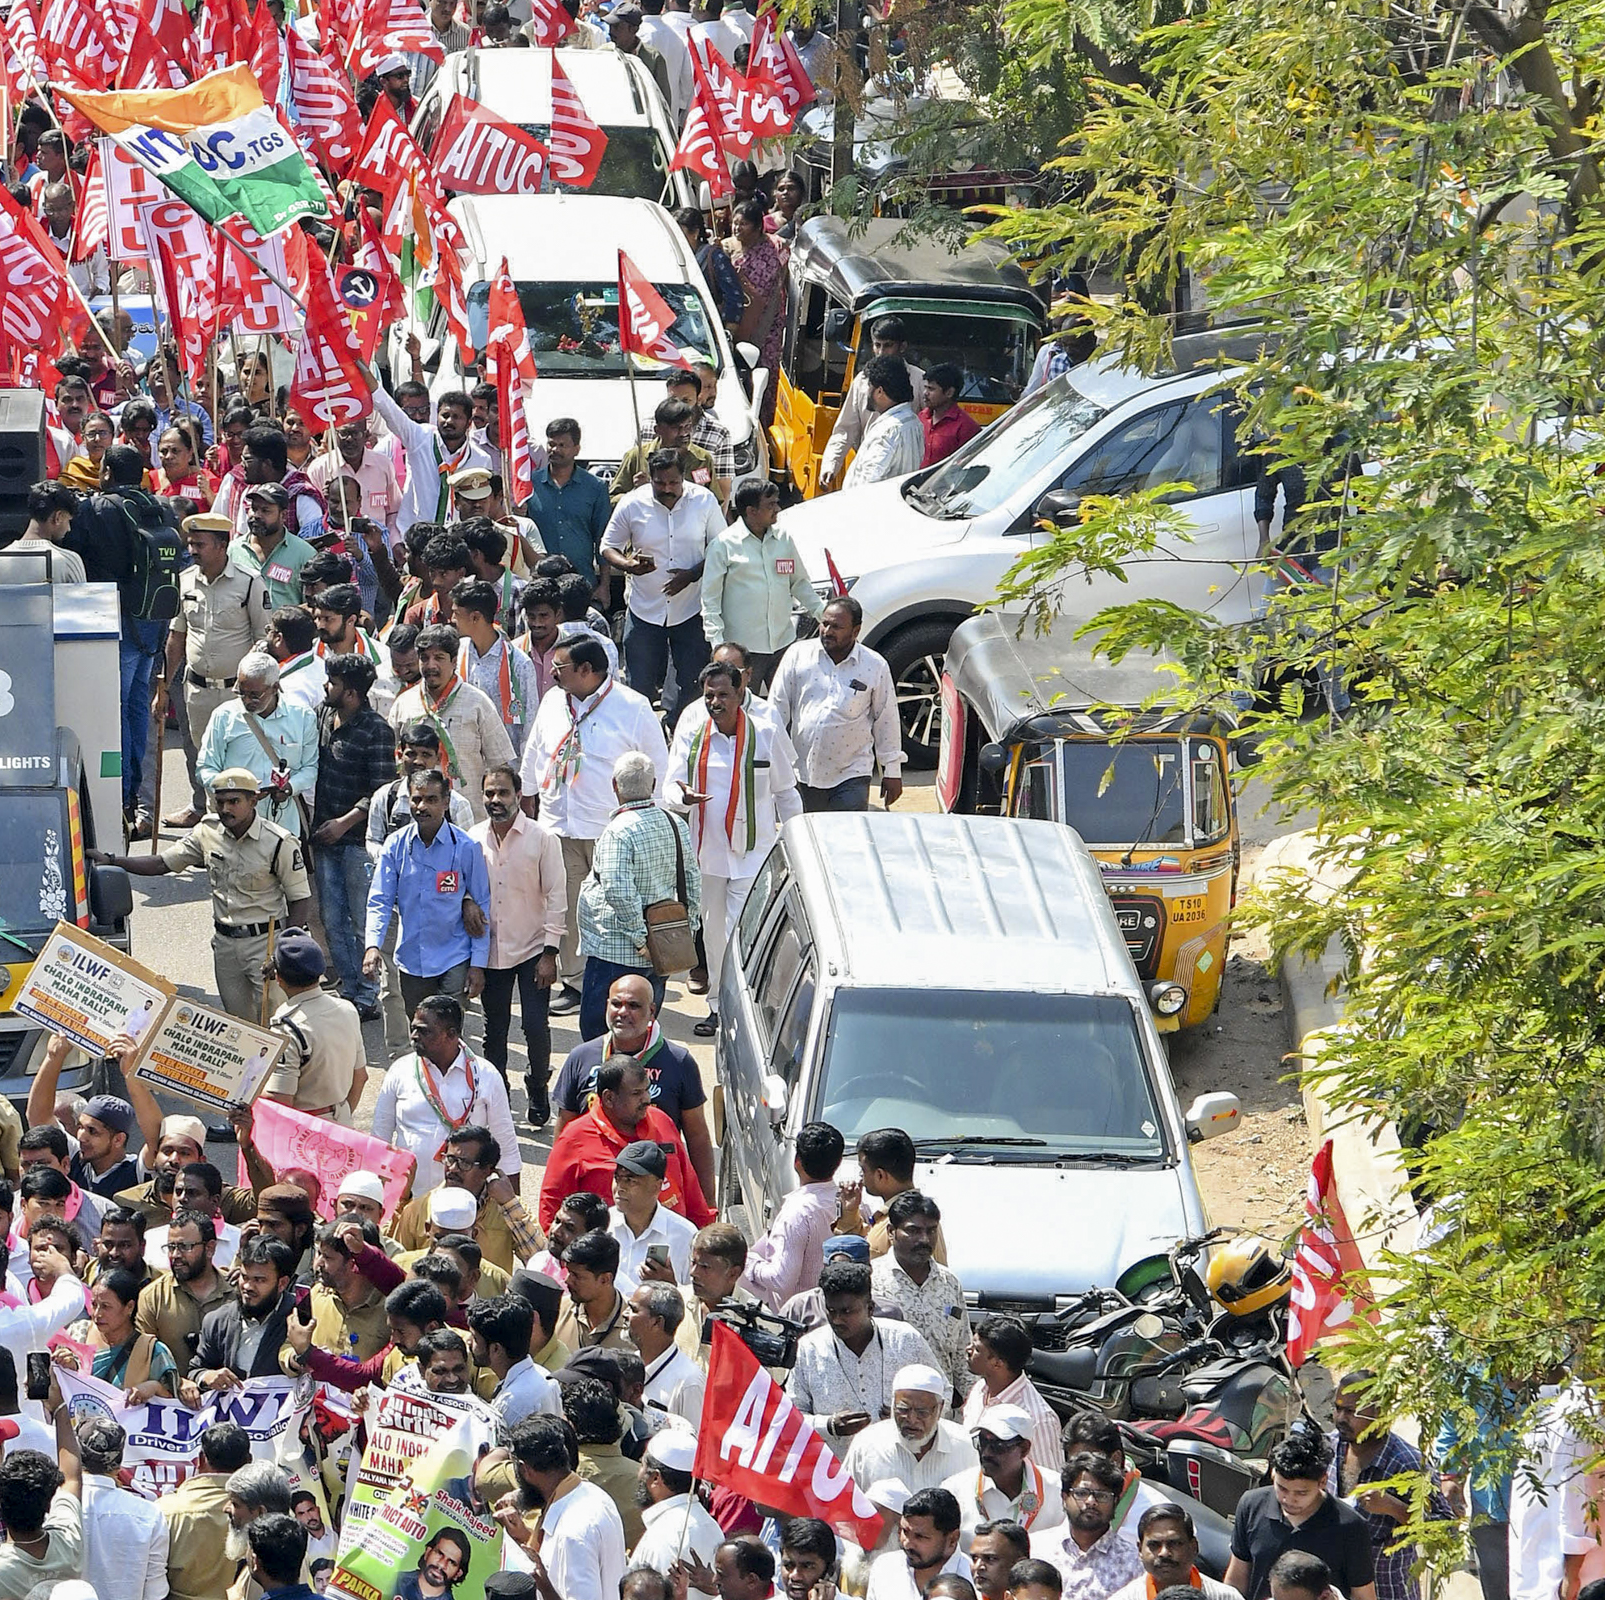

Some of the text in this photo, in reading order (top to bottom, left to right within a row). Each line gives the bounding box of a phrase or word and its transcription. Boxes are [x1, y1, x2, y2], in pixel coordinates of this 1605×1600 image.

[439, 118, 546, 195] AITUC
[158, 547, 176, 556] TVU
[271, 565, 291, 582] AITUC
[72, 953, 111, 981] ILWF
[73, 980, 129, 1015] INDRAPARK
[191, 1013, 228, 1037] ILWF
[192, 1039, 245, 1065] INDRAPARK
[405, 1404, 448, 1424] India
[134, 1436, 183, 1452] Driver
[370, 1452, 404, 1475] MAHA
[434, 1489, 497, 1539] Shaik Majeed
[400, 1516, 428, 1542] AUTO
